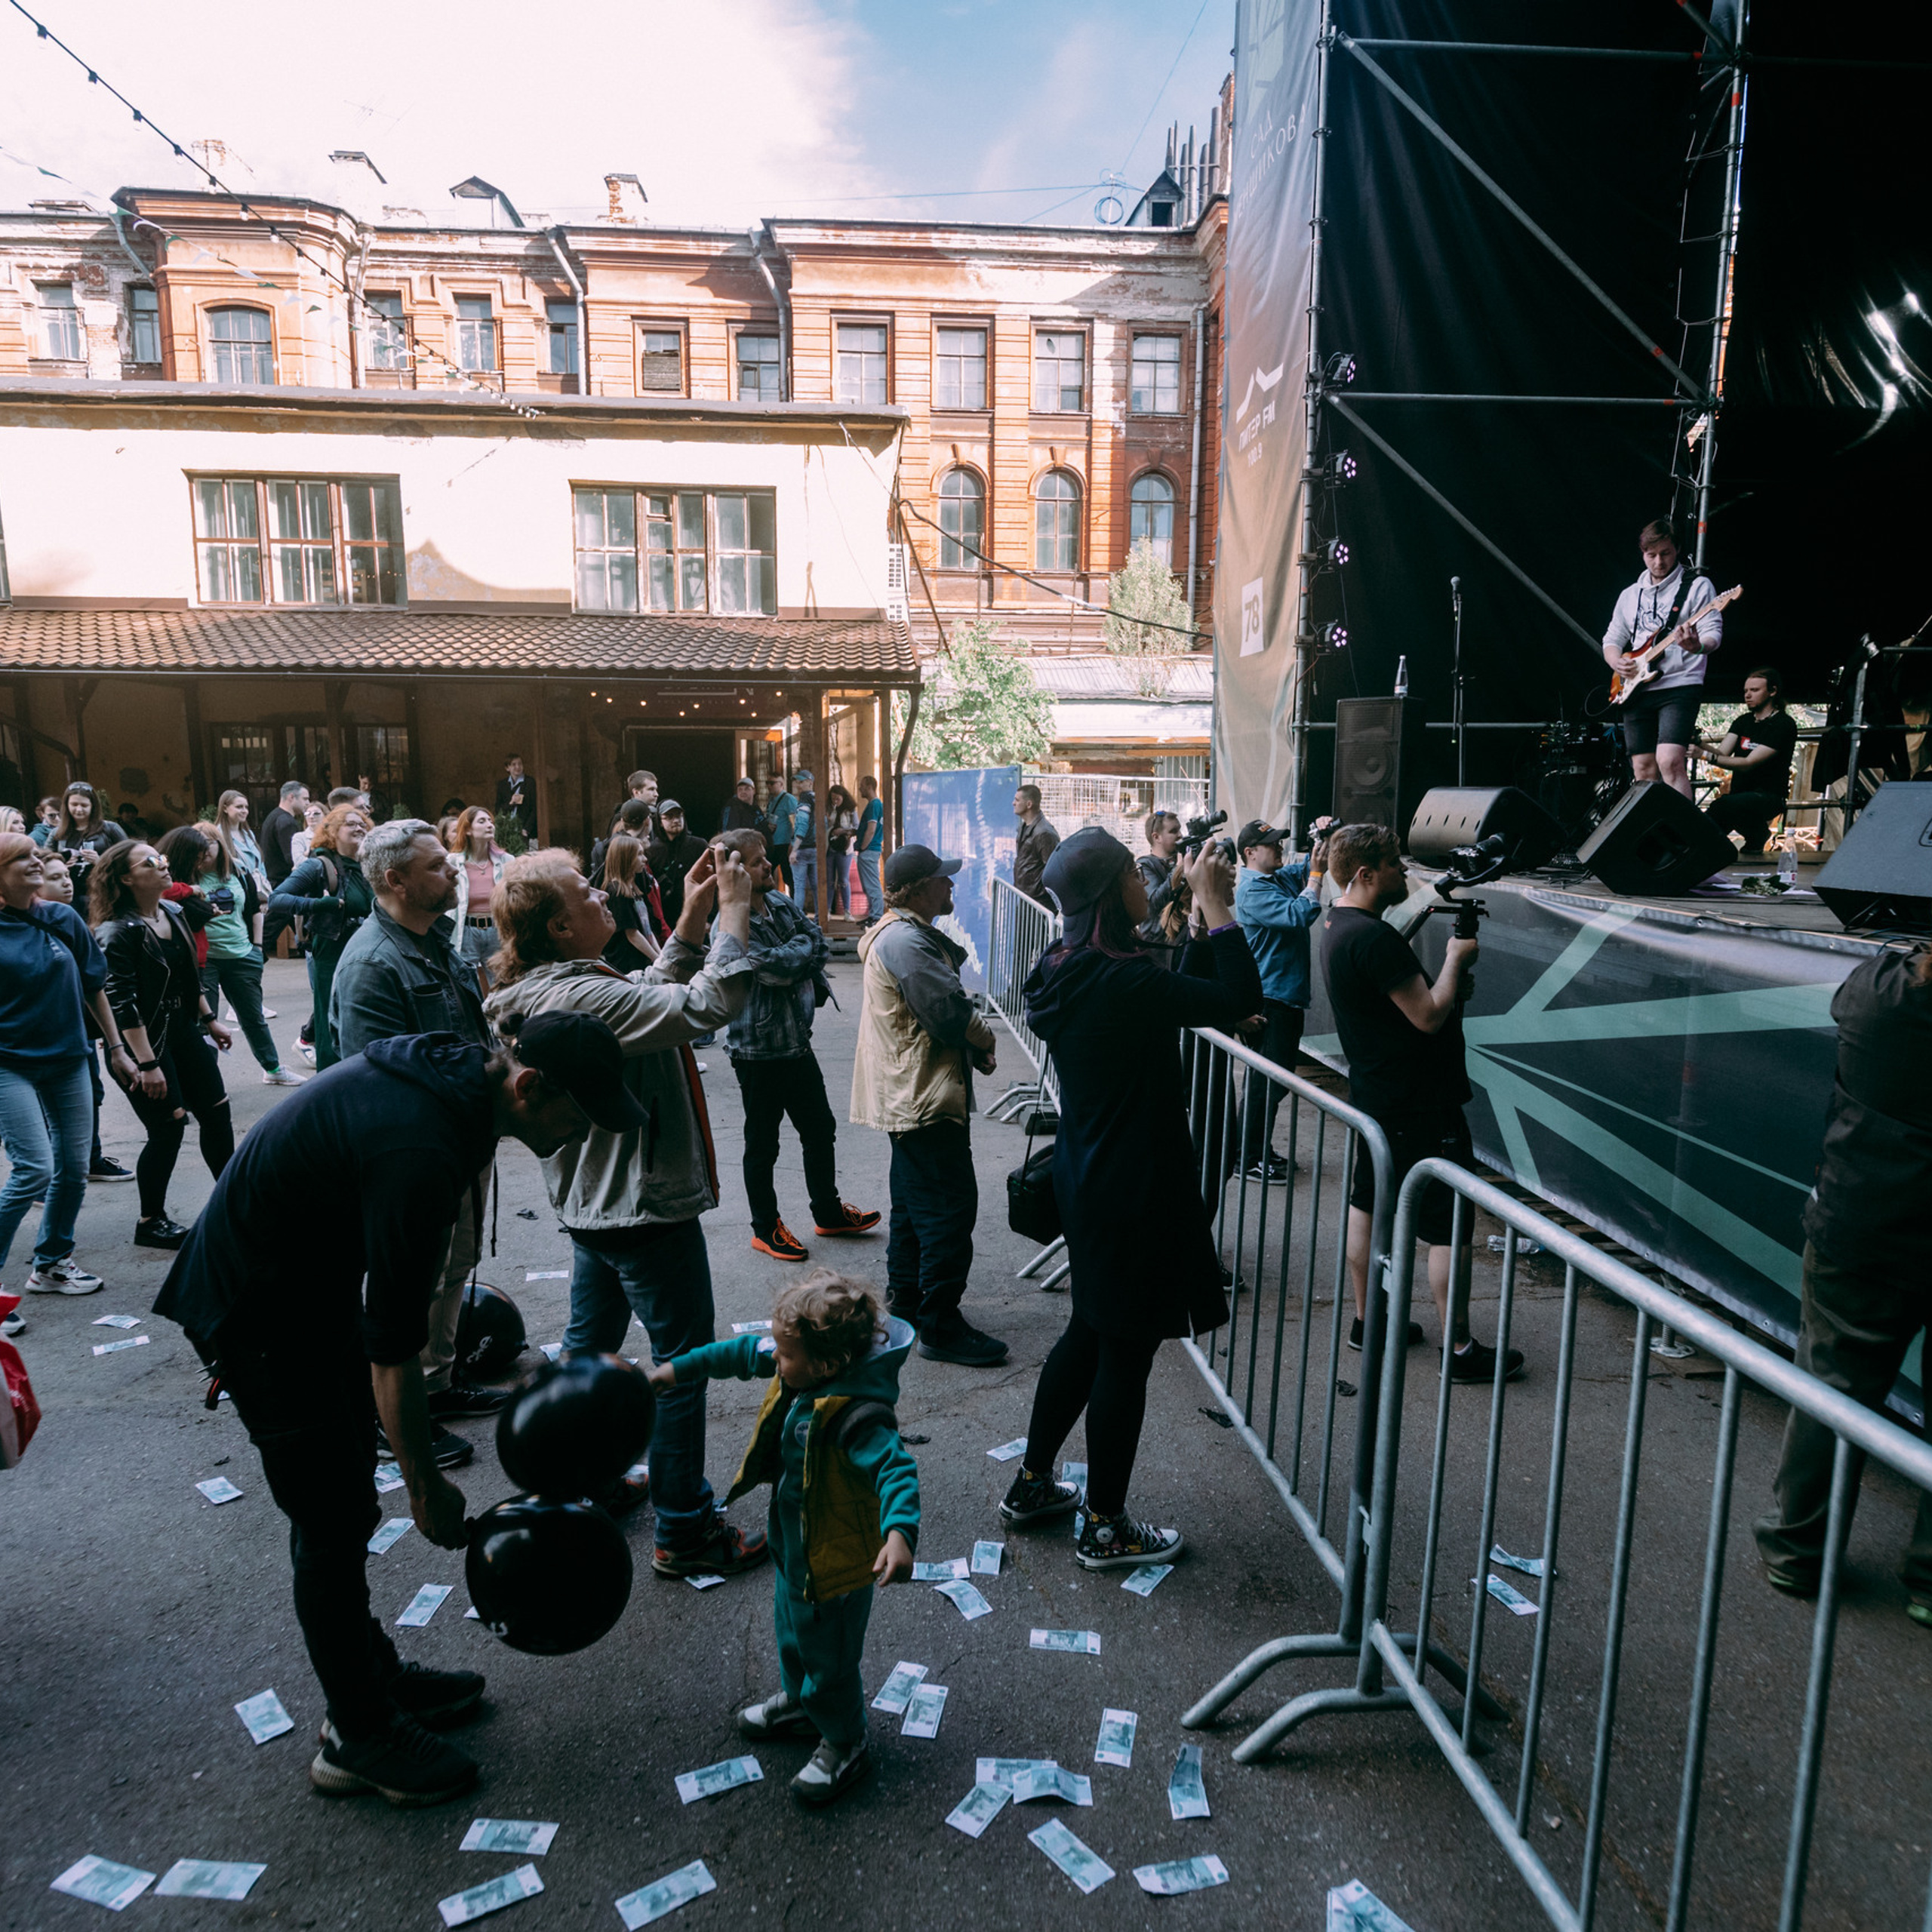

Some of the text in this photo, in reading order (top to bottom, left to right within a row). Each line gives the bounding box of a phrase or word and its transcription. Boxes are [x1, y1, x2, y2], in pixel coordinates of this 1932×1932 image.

[1238, 400, 1275, 453] ПИТЕР FM
[1247, 442, 1263, 468] 100.9
[1244, 594, 1260, 642] 78
